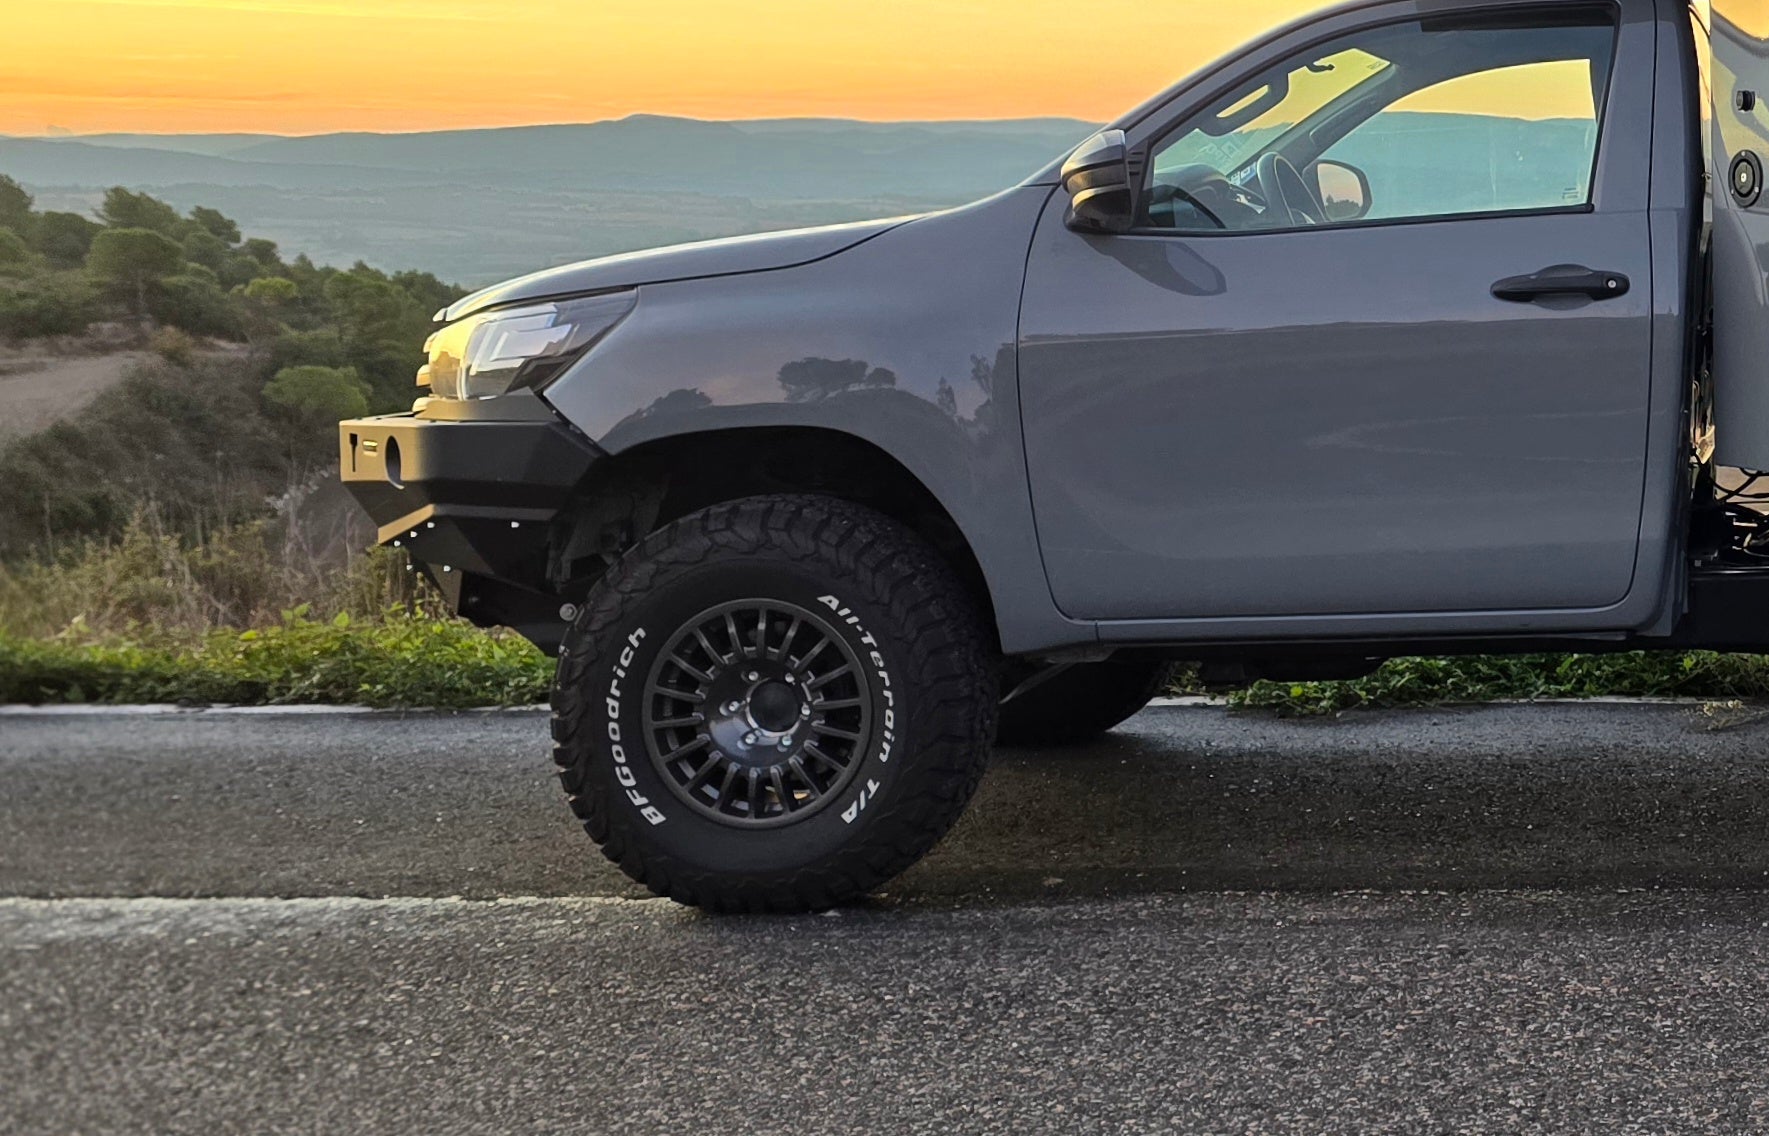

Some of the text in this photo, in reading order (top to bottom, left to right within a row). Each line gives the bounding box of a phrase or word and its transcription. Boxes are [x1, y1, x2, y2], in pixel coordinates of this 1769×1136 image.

[606, 627, 667, 826] BFGoodrich
[818, 594, 895, 824] All-Terrain T/A
